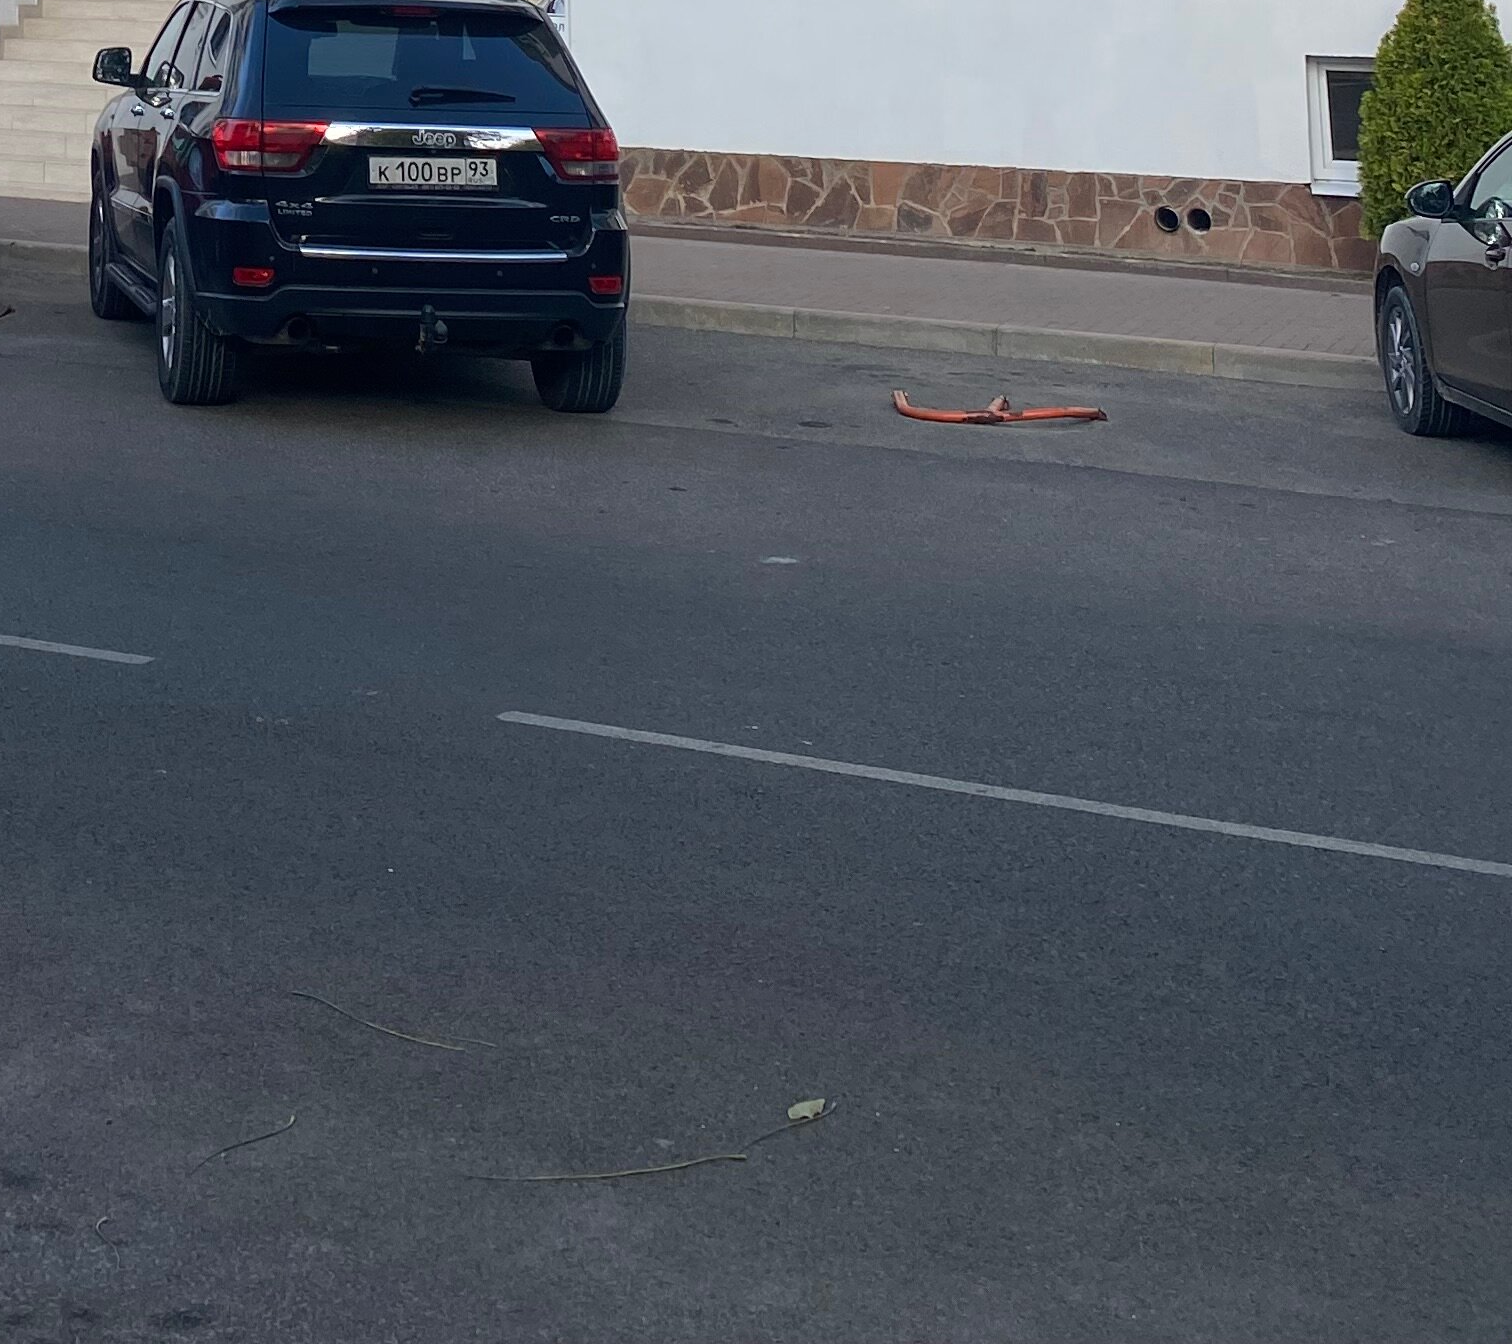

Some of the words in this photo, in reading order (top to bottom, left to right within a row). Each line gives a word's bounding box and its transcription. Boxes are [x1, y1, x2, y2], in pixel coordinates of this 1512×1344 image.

[412, 129, 456, 148] Jeep
[468, 161, 489, 178] 93
[549, 215, 581, 223] CRD
